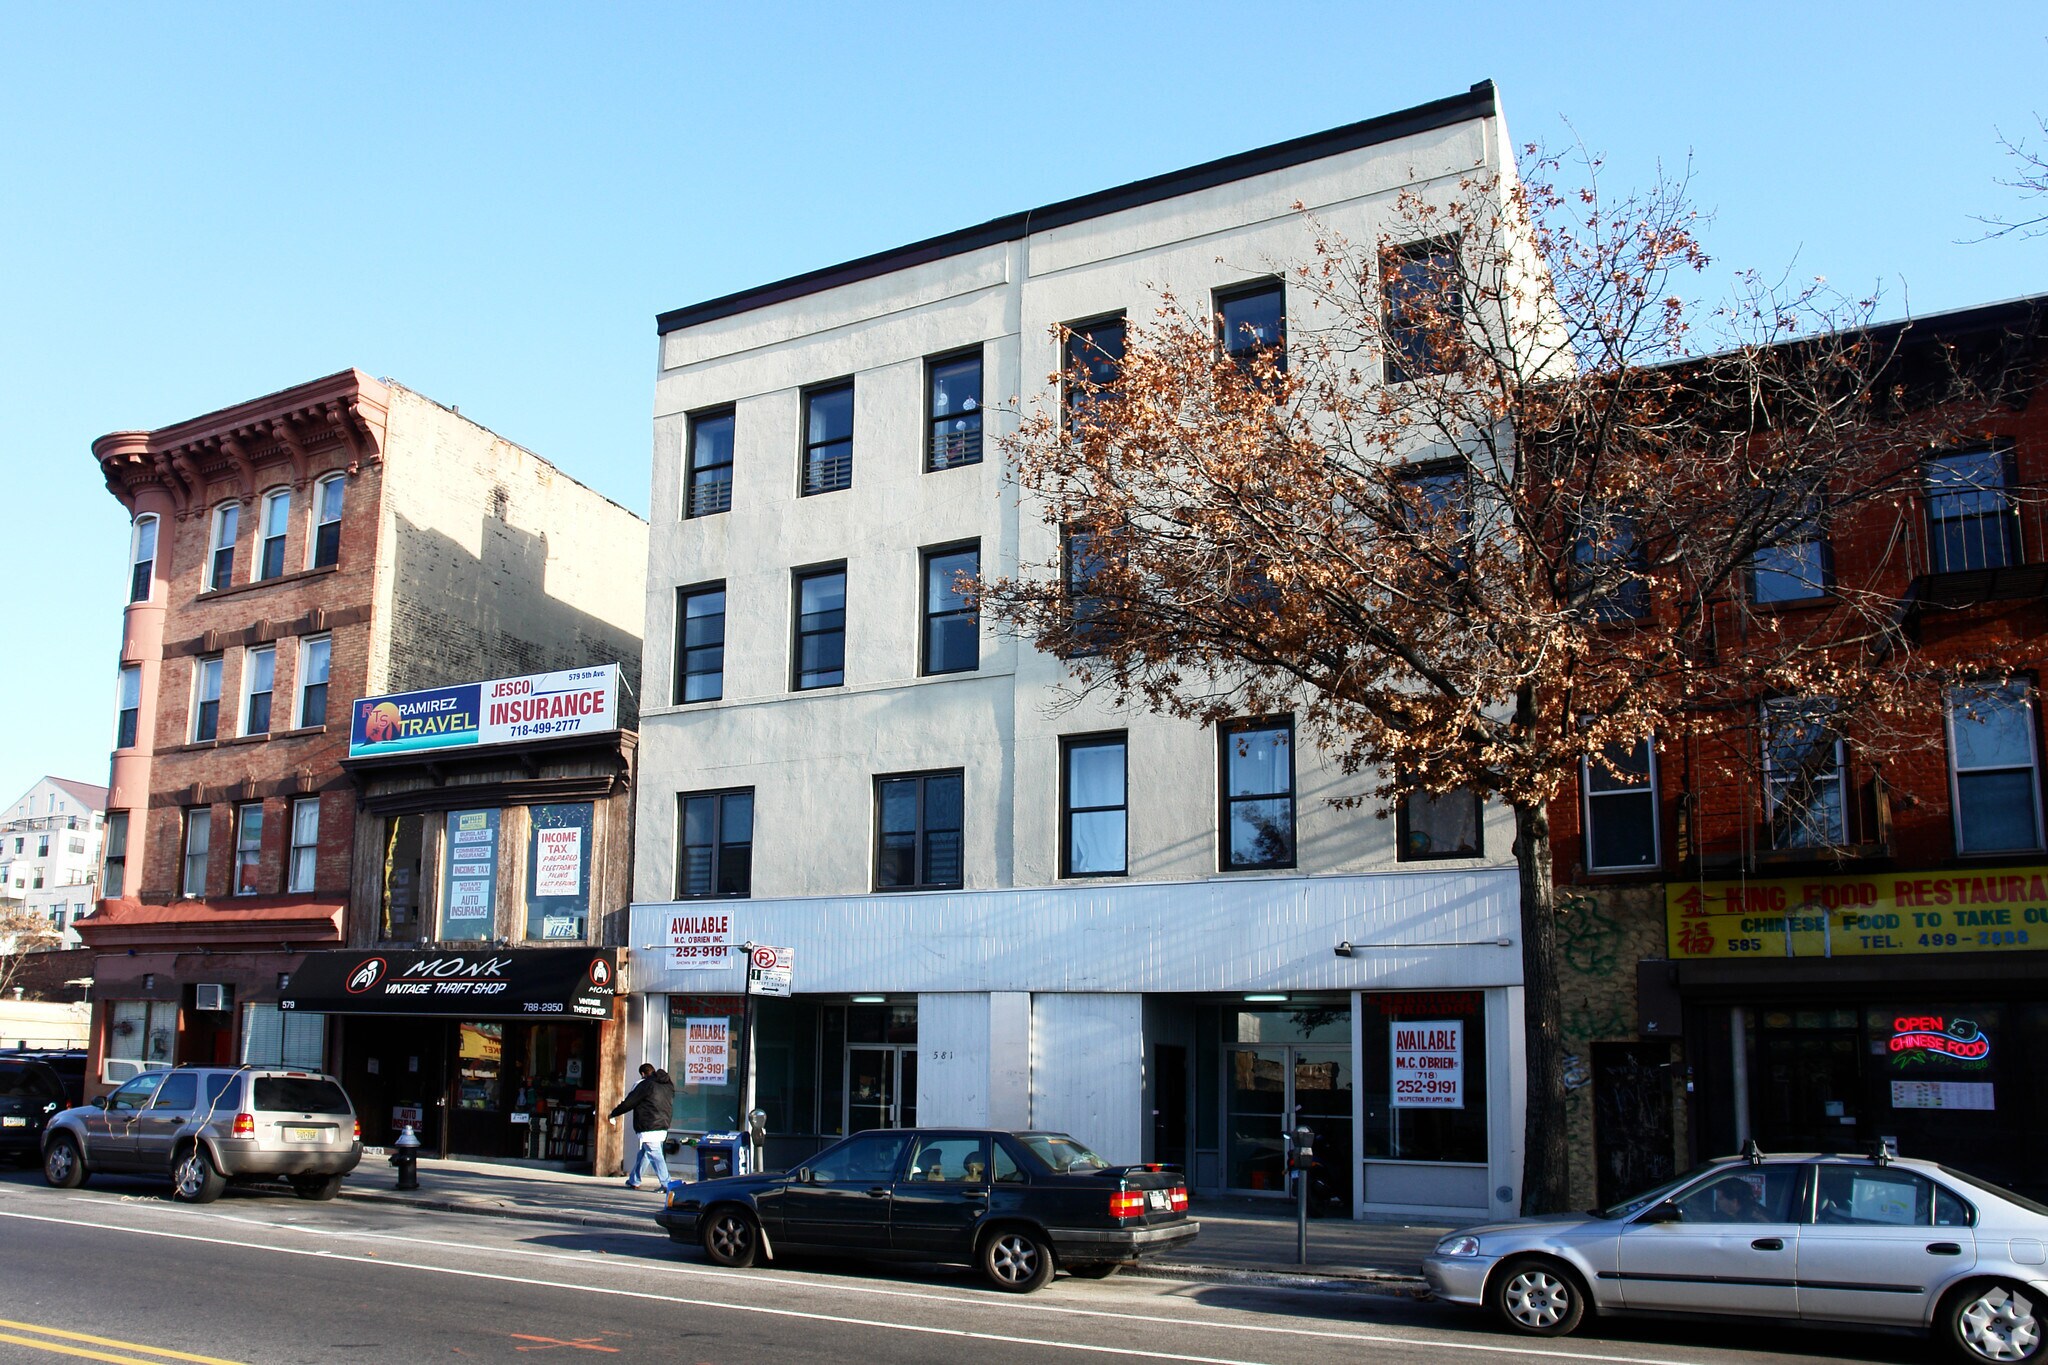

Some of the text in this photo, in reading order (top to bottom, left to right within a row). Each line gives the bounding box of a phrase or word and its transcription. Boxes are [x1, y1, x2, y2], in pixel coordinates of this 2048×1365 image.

[569, 670, 606, 681] 579 5th Ave.
[491, 680, 530, 698] JESCO
[398, 697, 457, 716] RAMIREZ
[490, 690, 605, 726] INSURANCE
[397, 712, 477, 737] TRAVEL
[510, 719, 581, 737] 718-499-2777
[541, 832, 577, 843] INCOME
[547, 844, 568, 854] TAX
[542, 854, 578, 862] PREPARED
[454, 865, 489, 874] INCOME TAX
[460, 895, 479, 905] AUTO
[1726, 886, 1786, 912] KING
[1802, 883, 1877, 910] FOOD
[451, 906, 487, 917] INSURANCE
[671, 916, 728, 934] AVAILABLE
[1741, 916, 1825, 932] CHINESE
[1843, 913, 1900, 931] FOOD
[1912, 912, 1942, 928] TO
[1953, 909, 2011, 926] TAKE
[674, 936, 686, 944] M.C.
[688, 936, 711, 944] O'BRIEN
[1728, 938, 1761, 951] 585
[676, 946, 728, 957] 252-9191
[403, 957, 512, 977] MONK
[385, 983, 507, 994] VINTAGE THRIFT SHOP
[588, 986, 614, 995] MONK
[282, 1001, 295, 1009] 579
[573, 1005, 606, 1015] THRIFT SHOP
[1893, 1016, 1945, 1032] OPEN
[690, 1024, 726, 1040] AVAILABLE
[1396, 1030, 1456, 1050] AVAILABLE
[1890, 1034, 1988, 1057] CHINESE FOOD
[702, 1045, 723, 1054] O'BRIEN
[933, 1051, 953, 1060] 581
[1396, 1057, 1418, 1069] M.C.
[1419, 1056, 1454, 1069] O'BRIEN
[1415, 1072, 1438, 1080] (718)
[400, 1109, 417, 1119] AUTO
